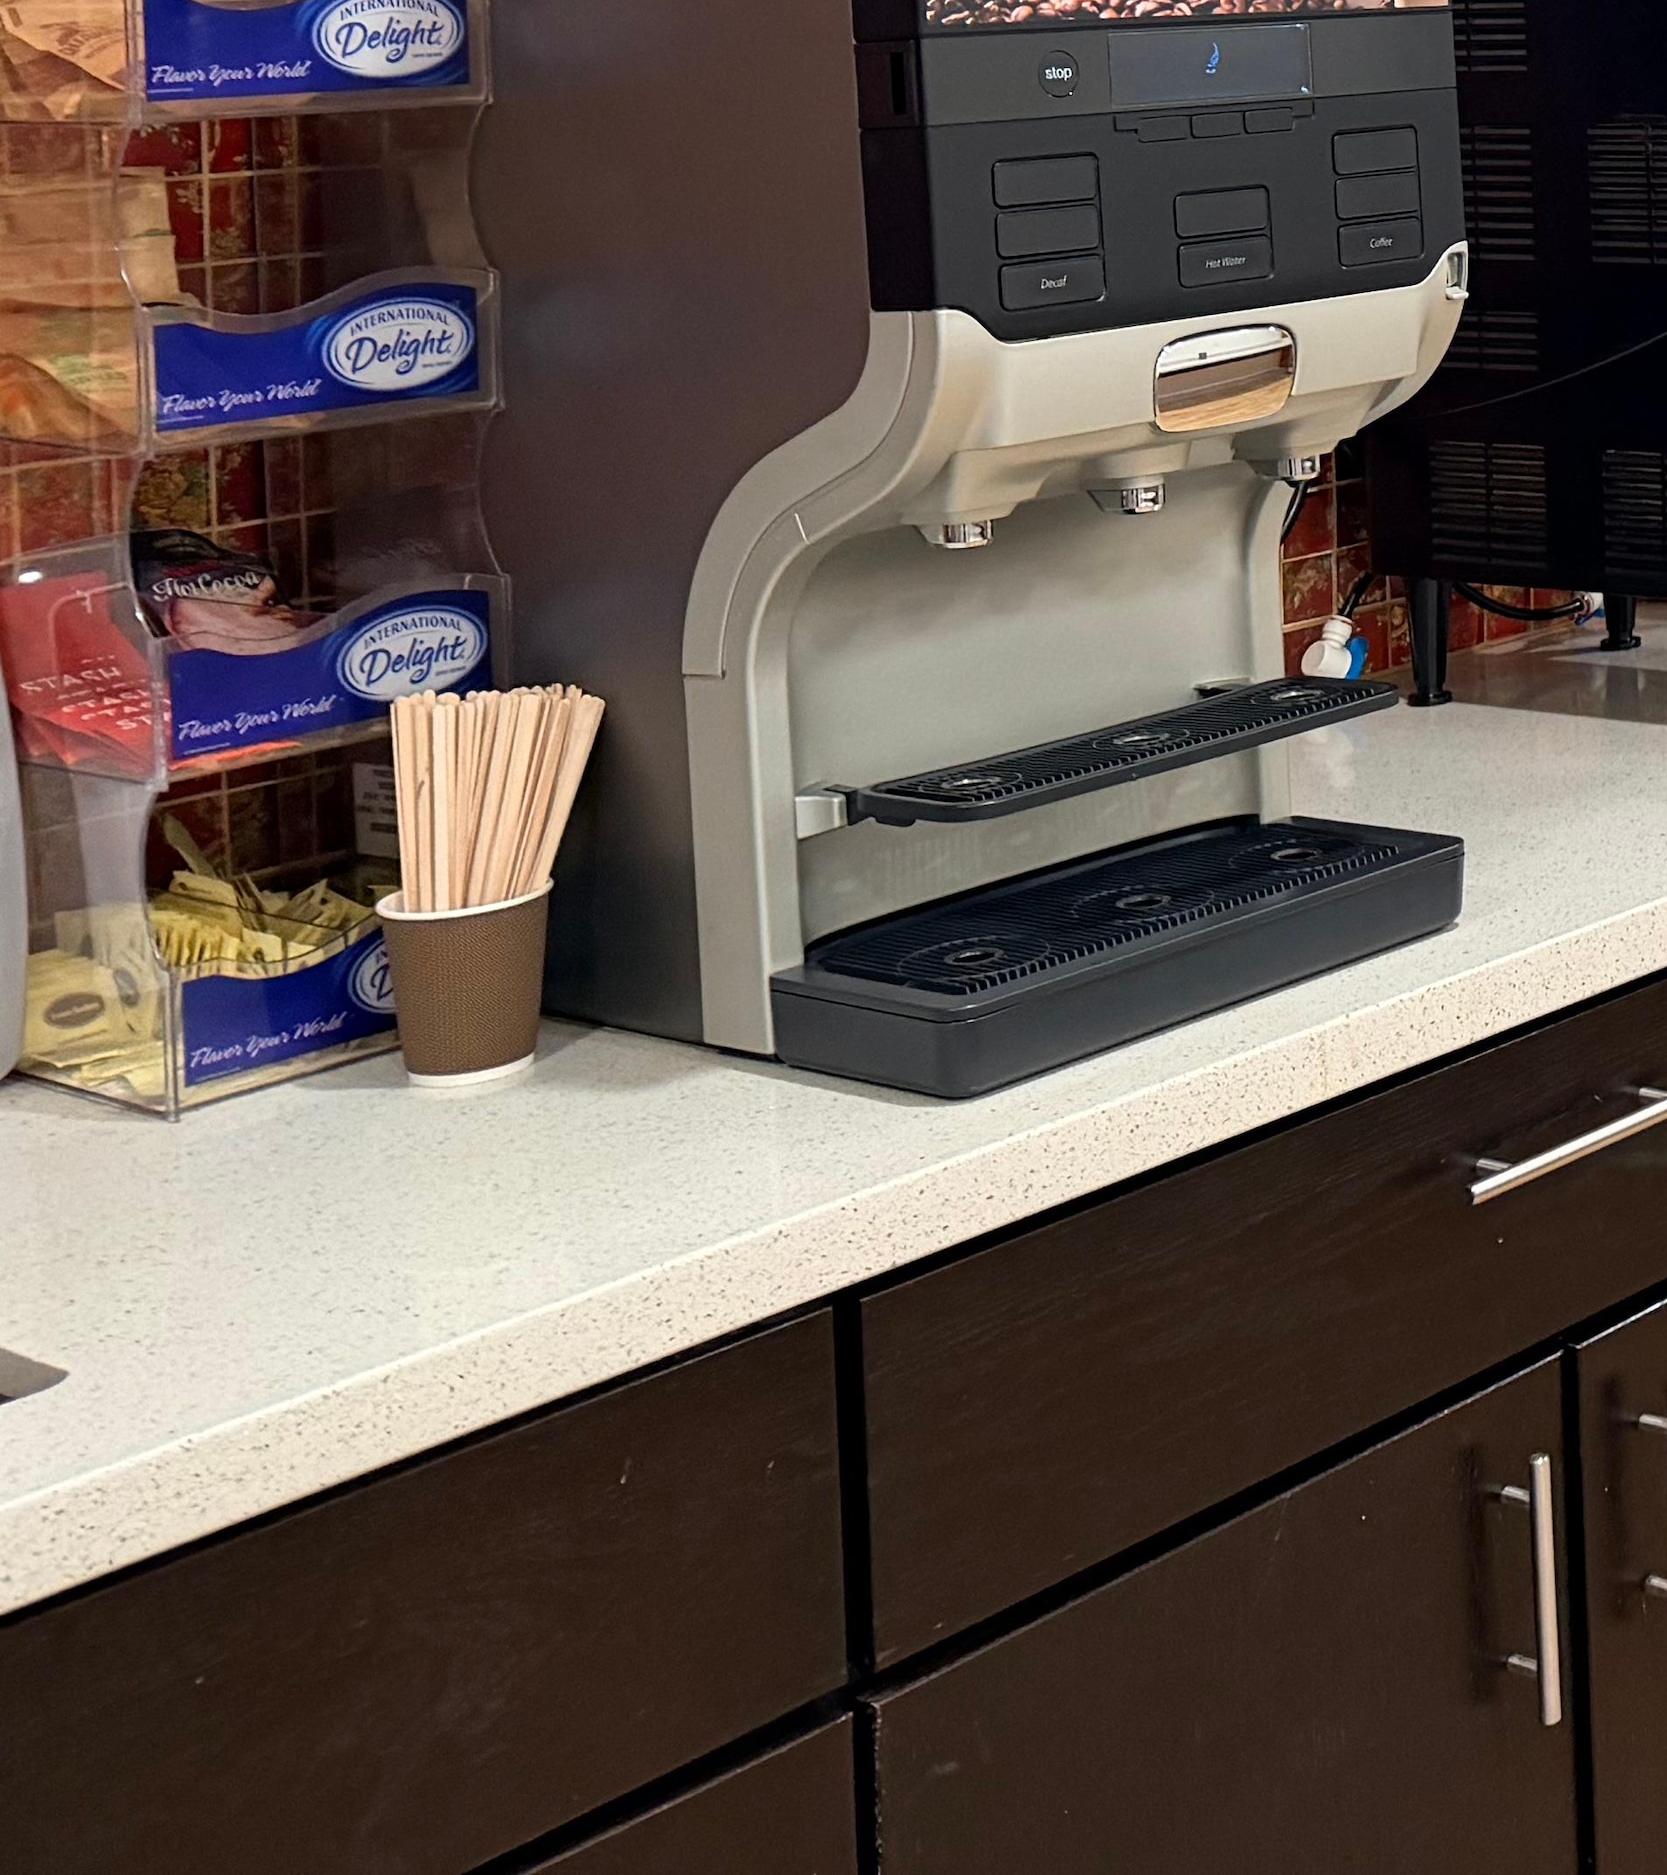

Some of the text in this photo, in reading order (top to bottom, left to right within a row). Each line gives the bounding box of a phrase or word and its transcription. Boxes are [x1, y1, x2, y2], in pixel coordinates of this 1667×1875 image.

[336, 16, 443, 63] Delight
[151, 60, 313, 86] Flavor Your World
[1045, 66, 1073, 82] stop
[1370, 237, 1393, 249] Coffee
[1205, 259, 1220, 269] Hot
[1041, 274, 1067, 290] Decaf
[350, 307, 450, 337] INTERNATIONAL
[345, 329, 454, 375] Delight
[162, 378, 323, 415] Flavor Your World
[198, 572, 260, 595] Cocoa
[364, 615, 461, 650] INTERNATIONAL
[360, 636, 467, 687] Delight
[20, 666, 121, 692] STASH
[178, 718, 231, 741] Flavor
[234, 711, 280, 736] Your
[282, 694, 338, 718] World
[190, 1011, 348, 1068] Flavor Your World
